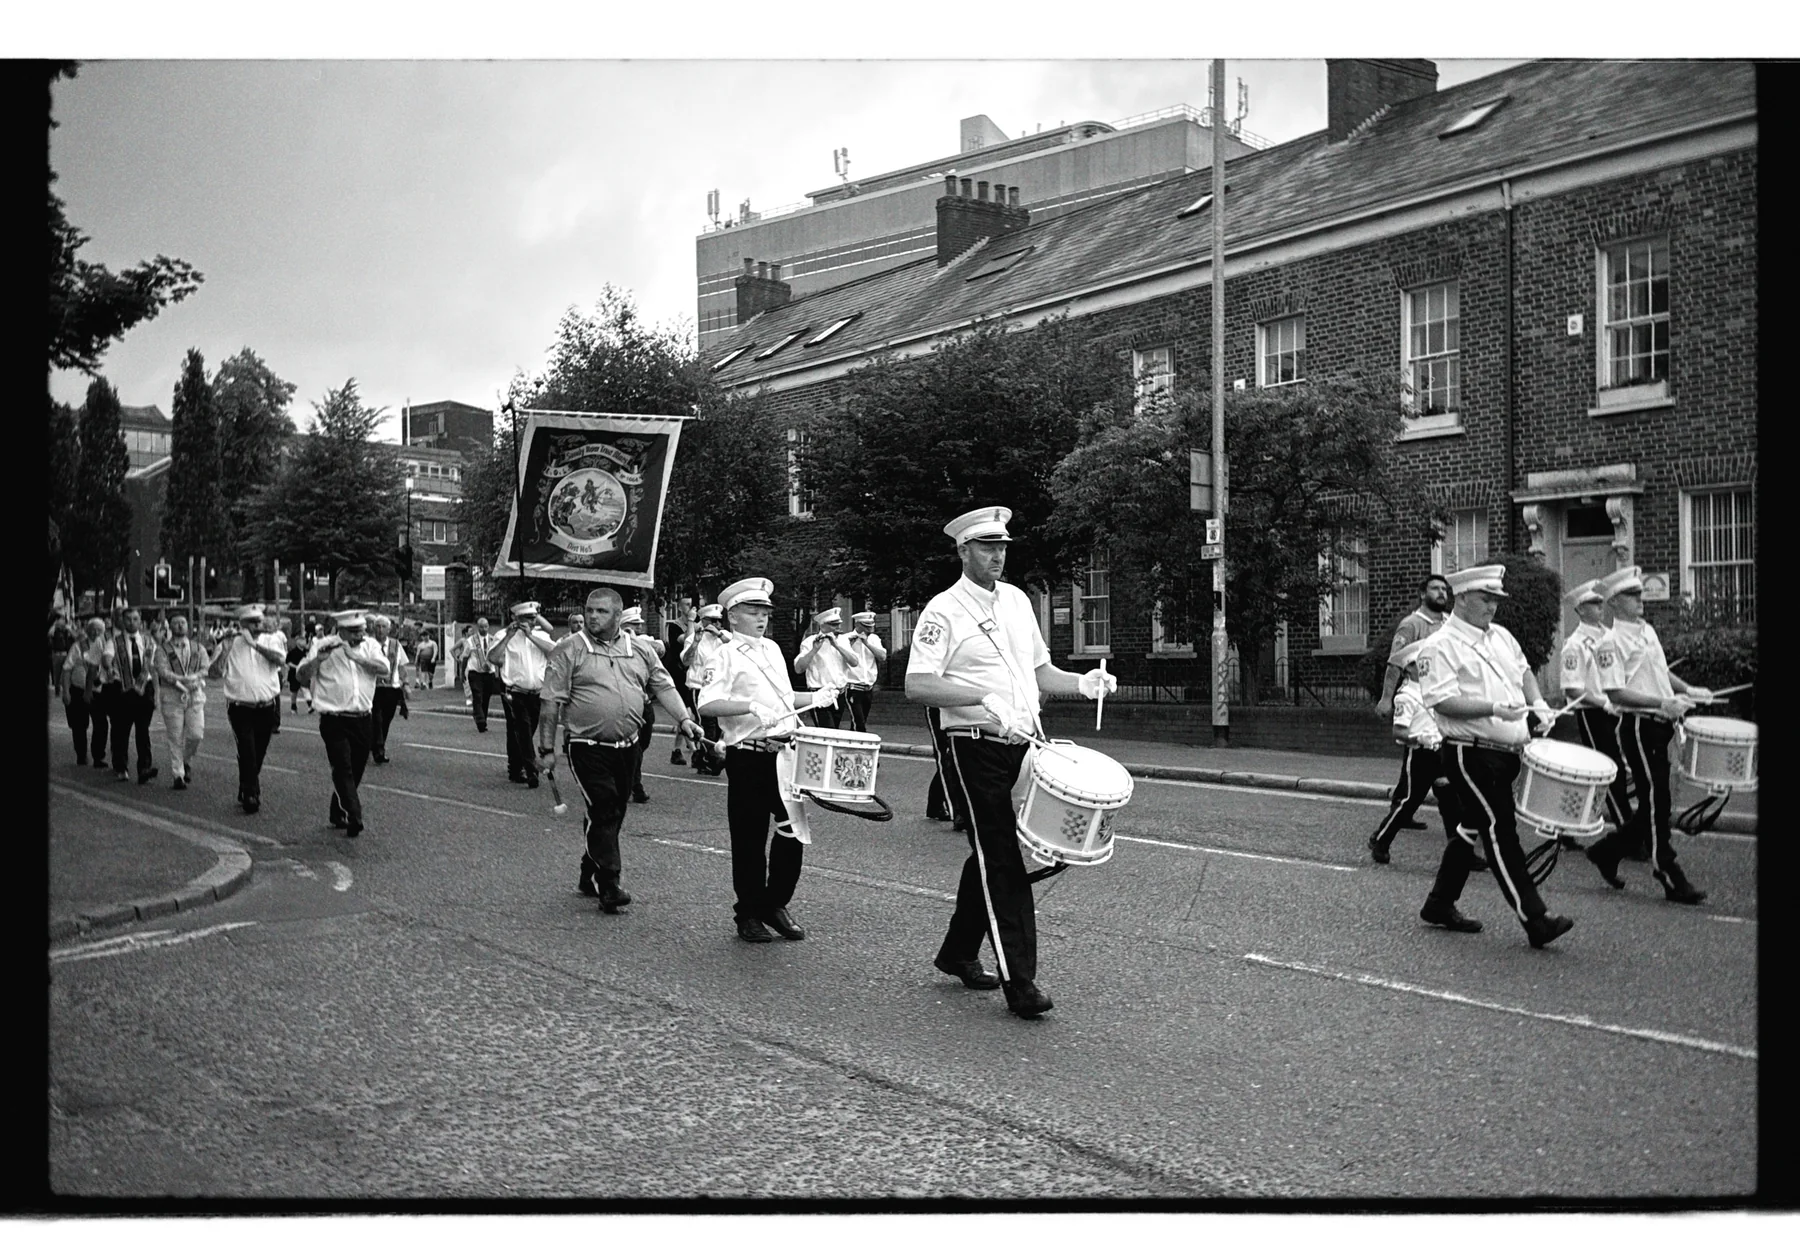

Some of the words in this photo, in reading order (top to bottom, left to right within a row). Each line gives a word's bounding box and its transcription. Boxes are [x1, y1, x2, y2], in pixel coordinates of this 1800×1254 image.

[566, 448, 585, 459] Sandy
[586, 445, 600, 453] Row
[600, 445, 613, 456] True
